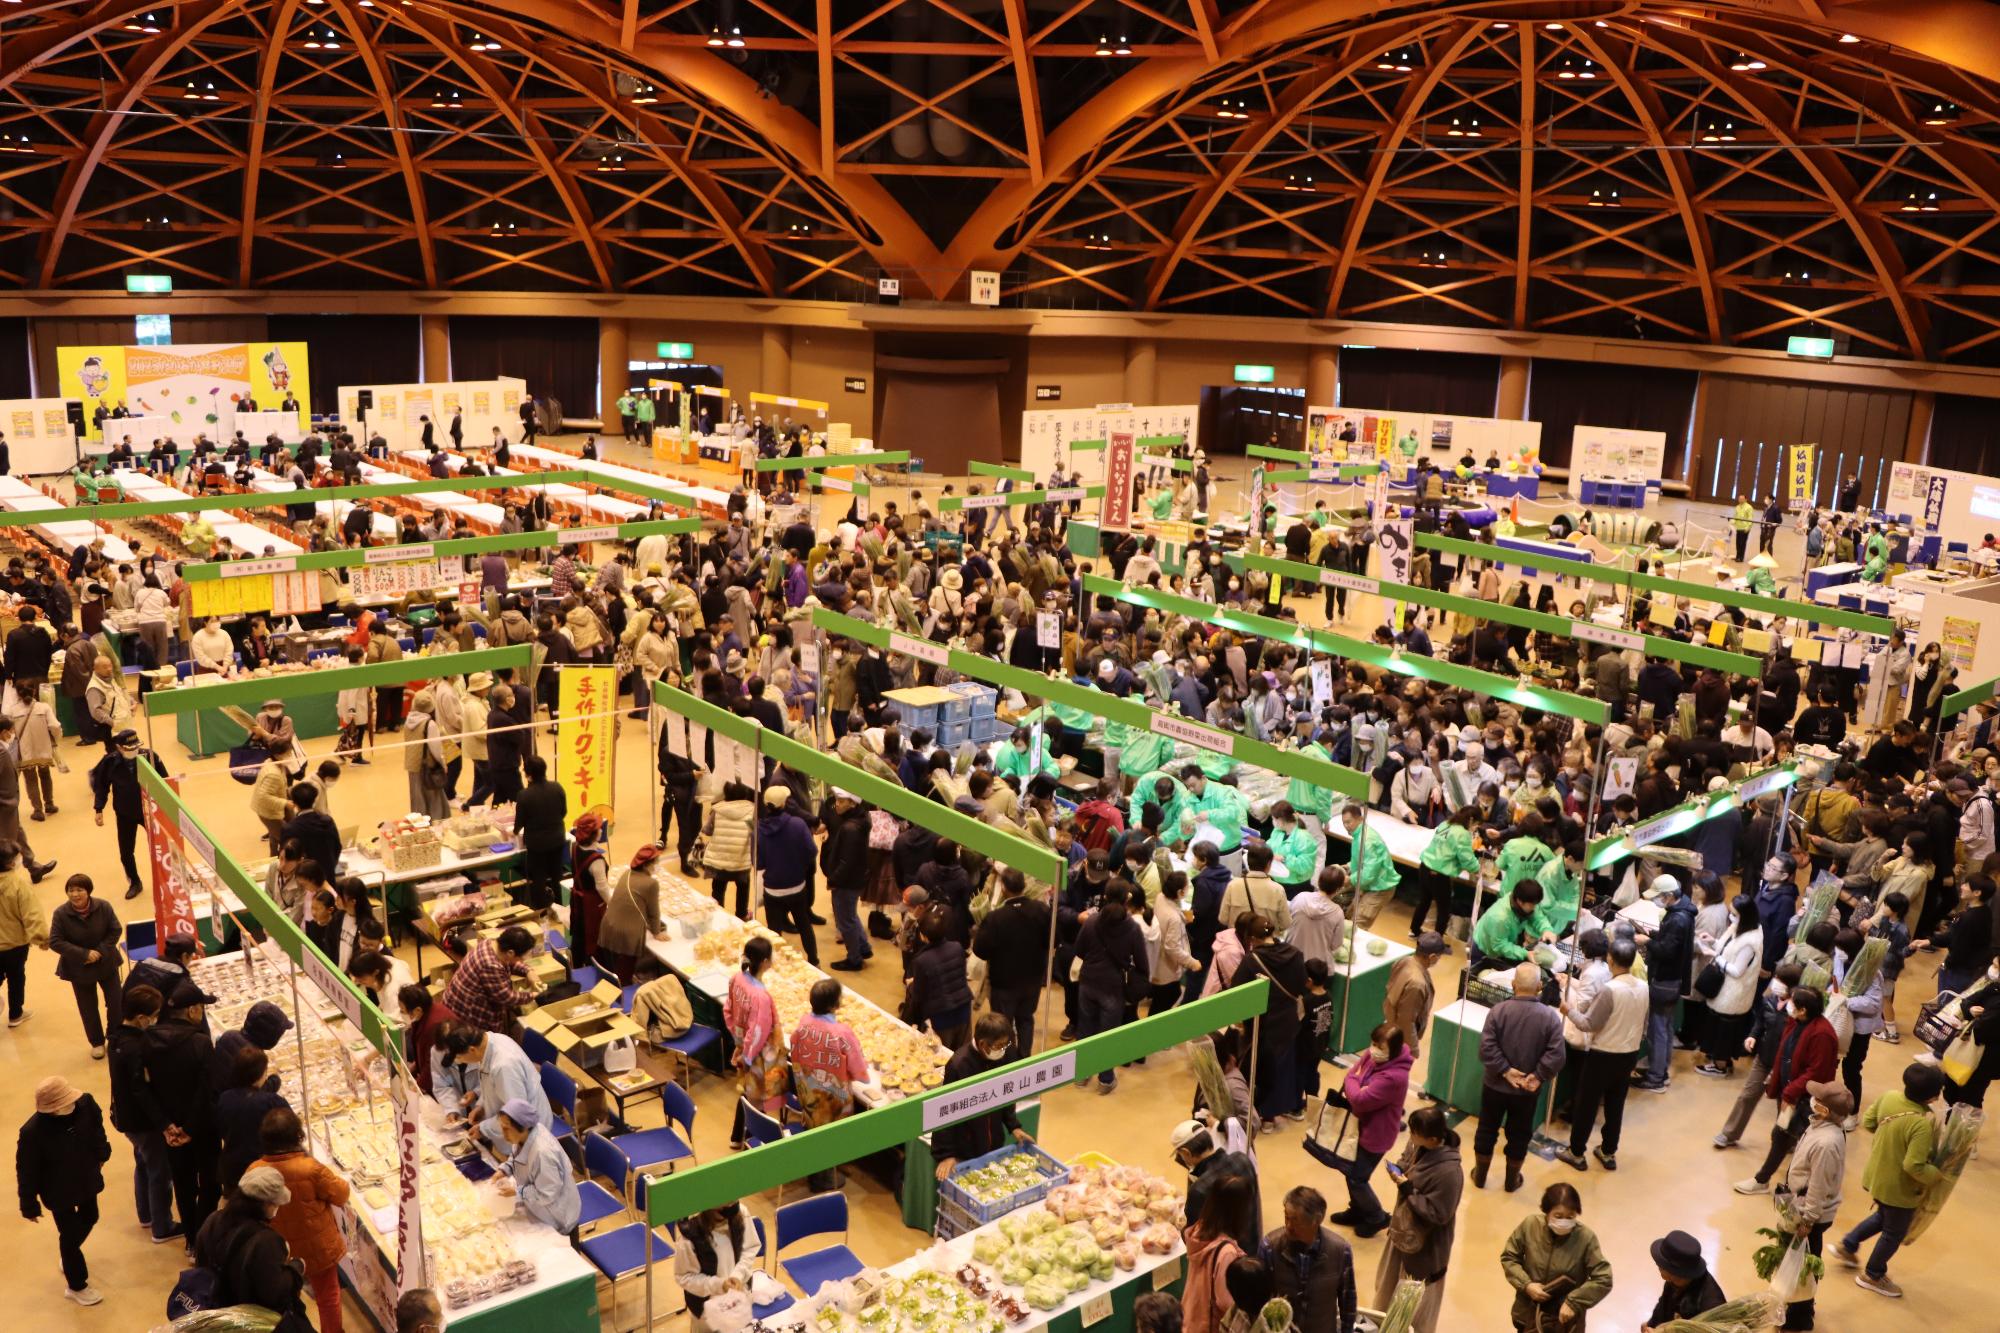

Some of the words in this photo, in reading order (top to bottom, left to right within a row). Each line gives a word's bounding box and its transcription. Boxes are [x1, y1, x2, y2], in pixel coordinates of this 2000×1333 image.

[1111, 450, 1128, 522] おいなりさん
[573, 676, 596, 807] 手作りクッキー
[939, 1090, 998, 1118] 農事組合法人
[175, 1291, 200, 1312] FILA
